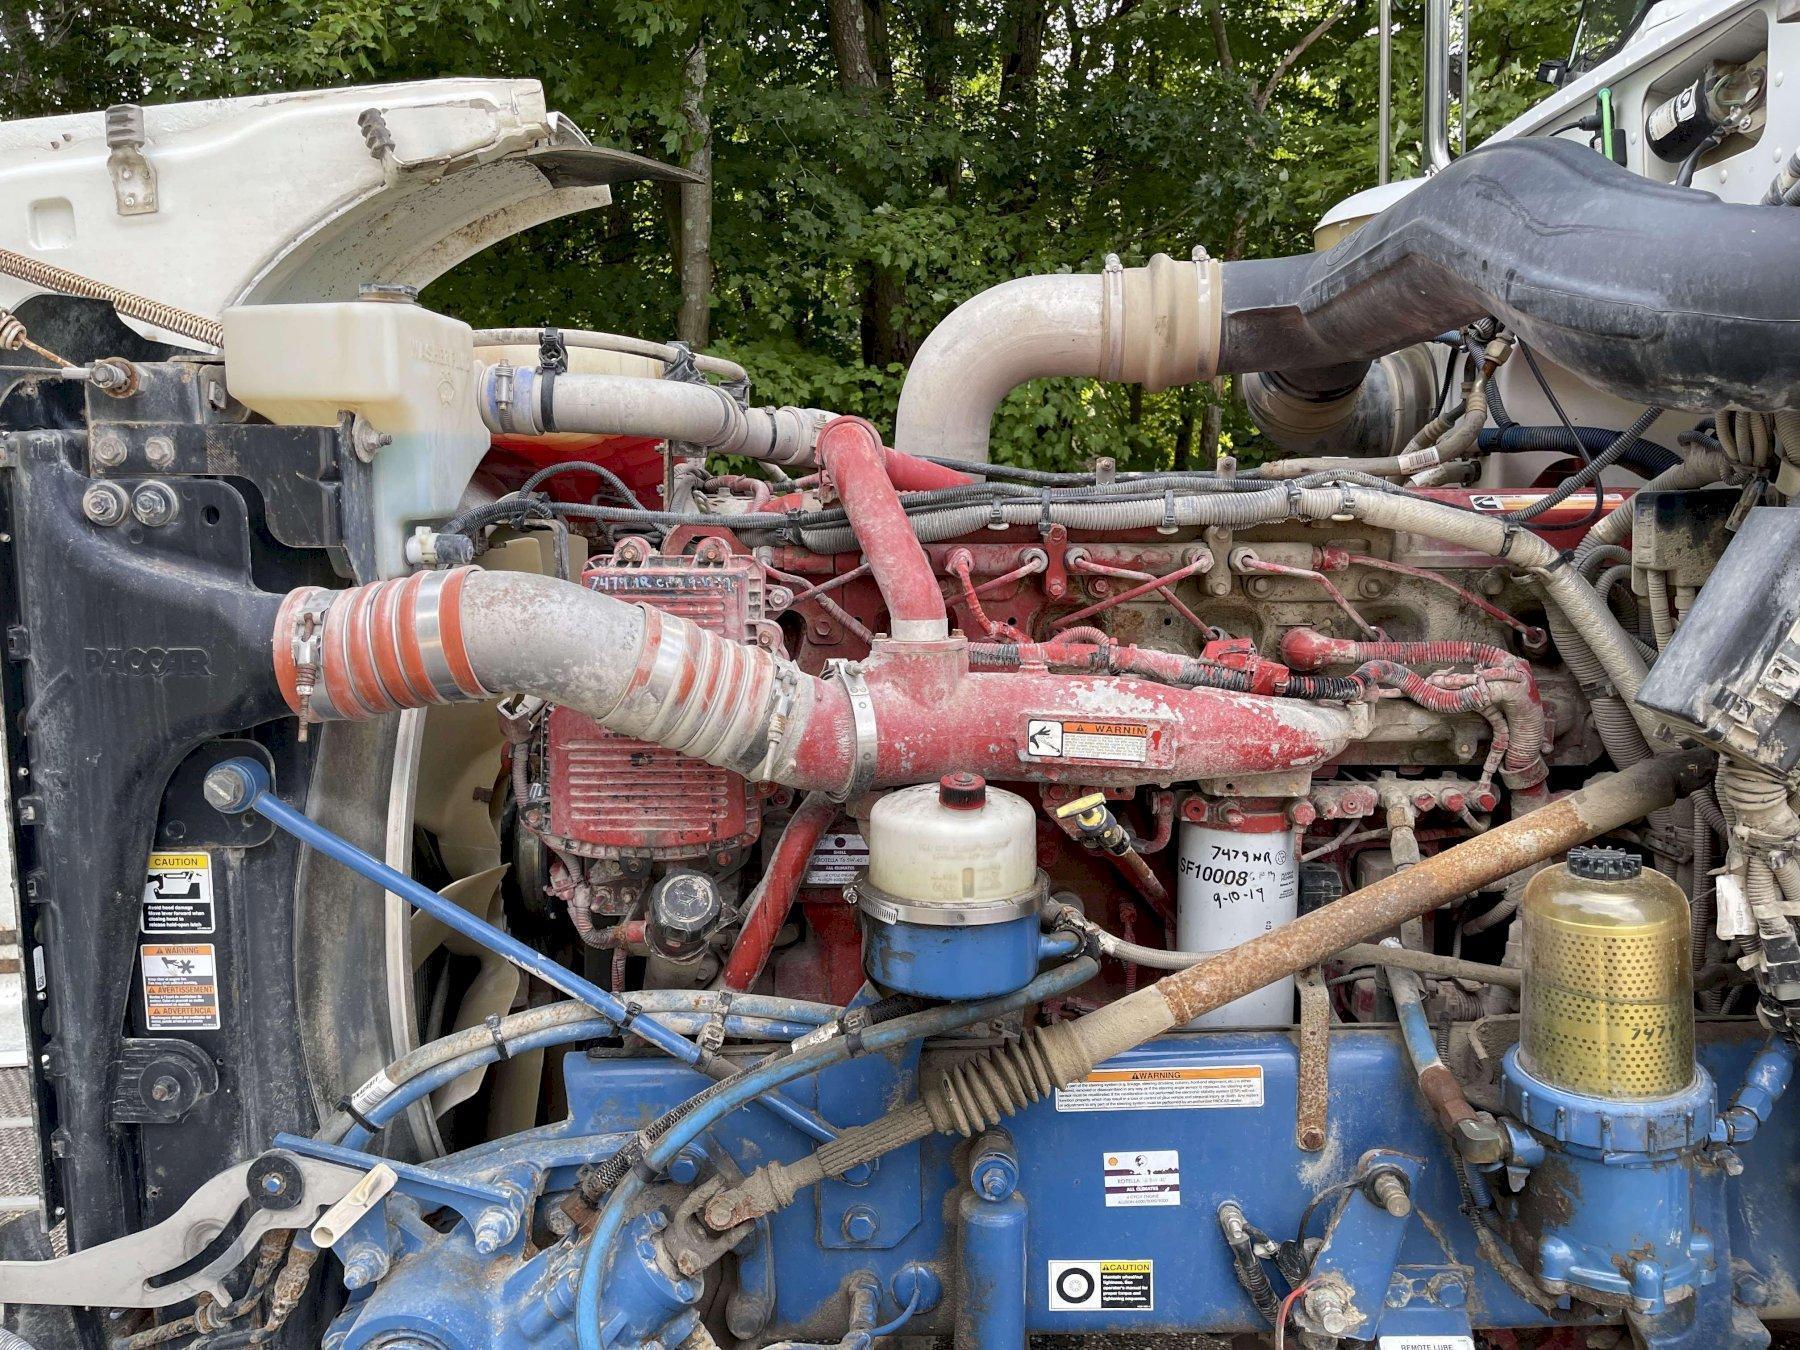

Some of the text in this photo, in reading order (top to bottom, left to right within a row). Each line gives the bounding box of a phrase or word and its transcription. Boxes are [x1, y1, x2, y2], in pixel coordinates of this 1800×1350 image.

[83, 646, 216, 677] PACCAR
[1211, 845, 1249, 863] 7479
[154, 858, 198, 866] CAUTION
[1180, 857, 1248, 887] SF10008
[165, 946, 199, 954] WARNING
[163, 1007, 212, 1015] ADVERTENCIA
[1140, 1071, 1181, 1079] WARNING
